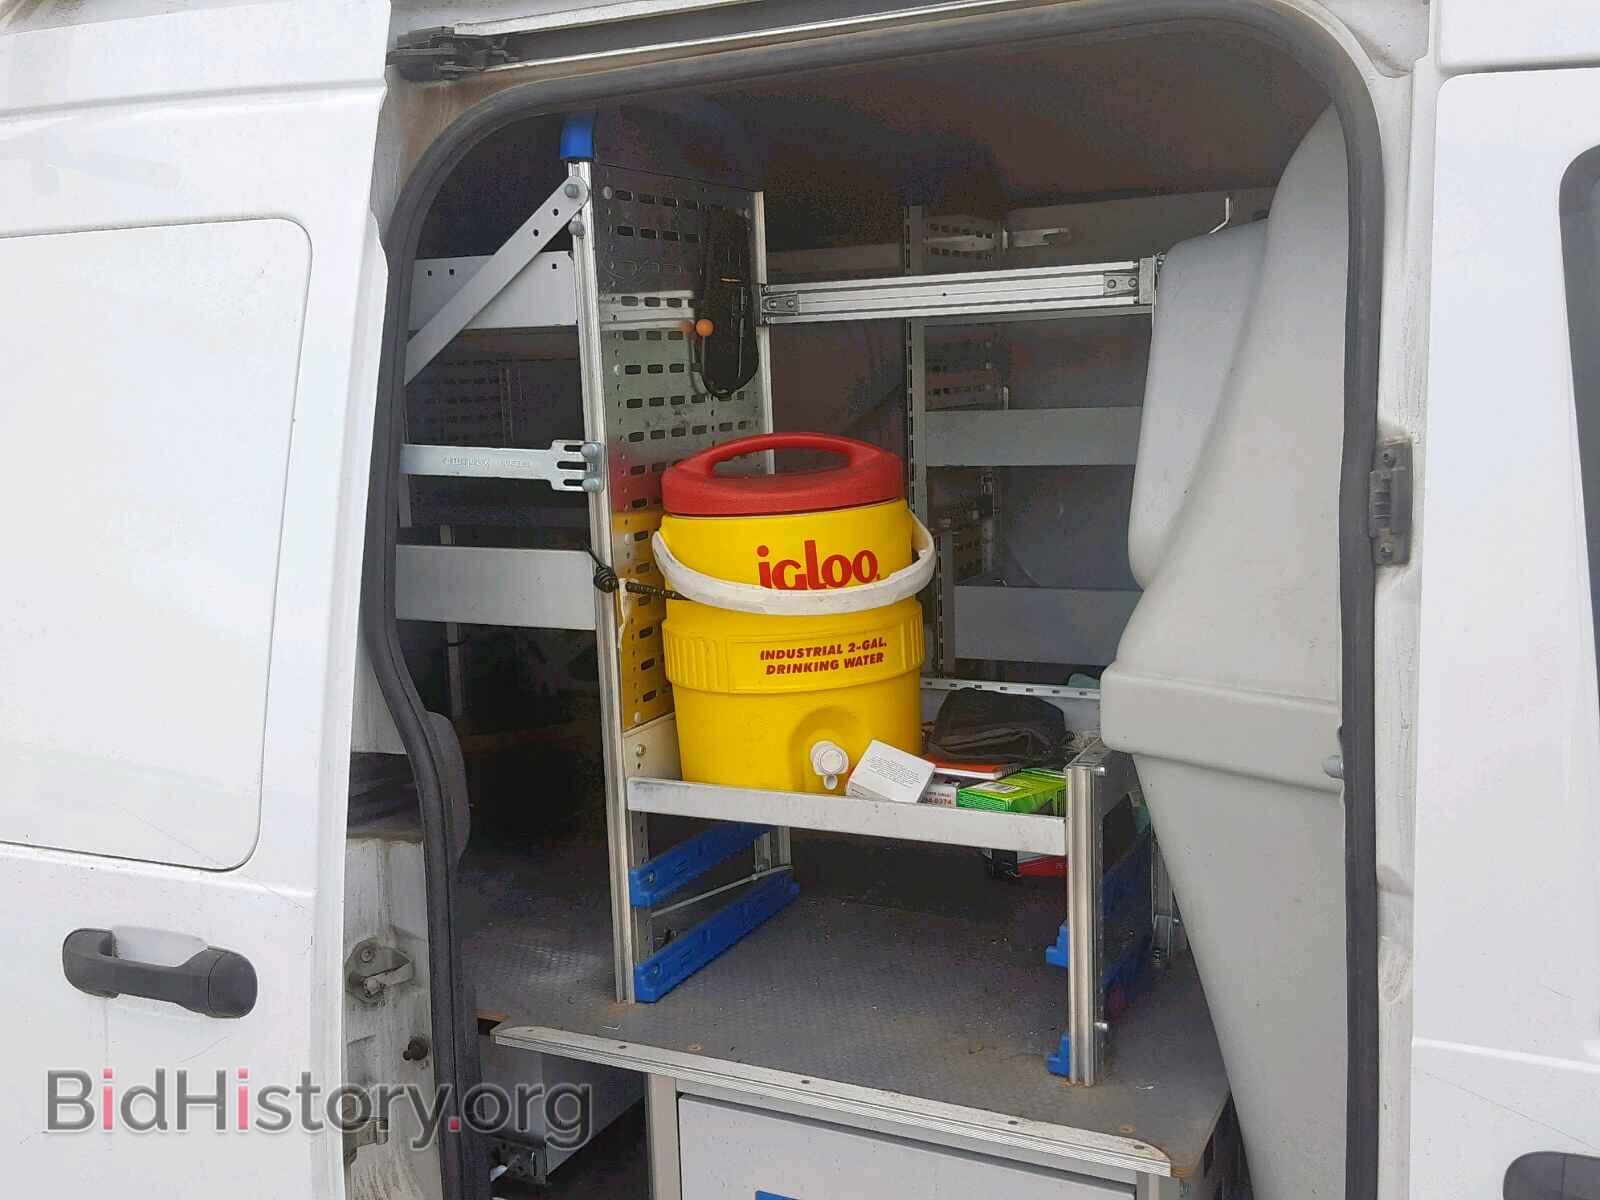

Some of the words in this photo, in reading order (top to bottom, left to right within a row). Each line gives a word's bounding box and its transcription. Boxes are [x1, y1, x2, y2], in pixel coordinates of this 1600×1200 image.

[757, 540, 878, 590] igloo
[760, 643, 844, 661] INDUSTRIAL
[848, 637, 887, 653] 2-GAL.
[766, 659, 840, 675] DRINKING
[843, 652, 885, 669] WATER
